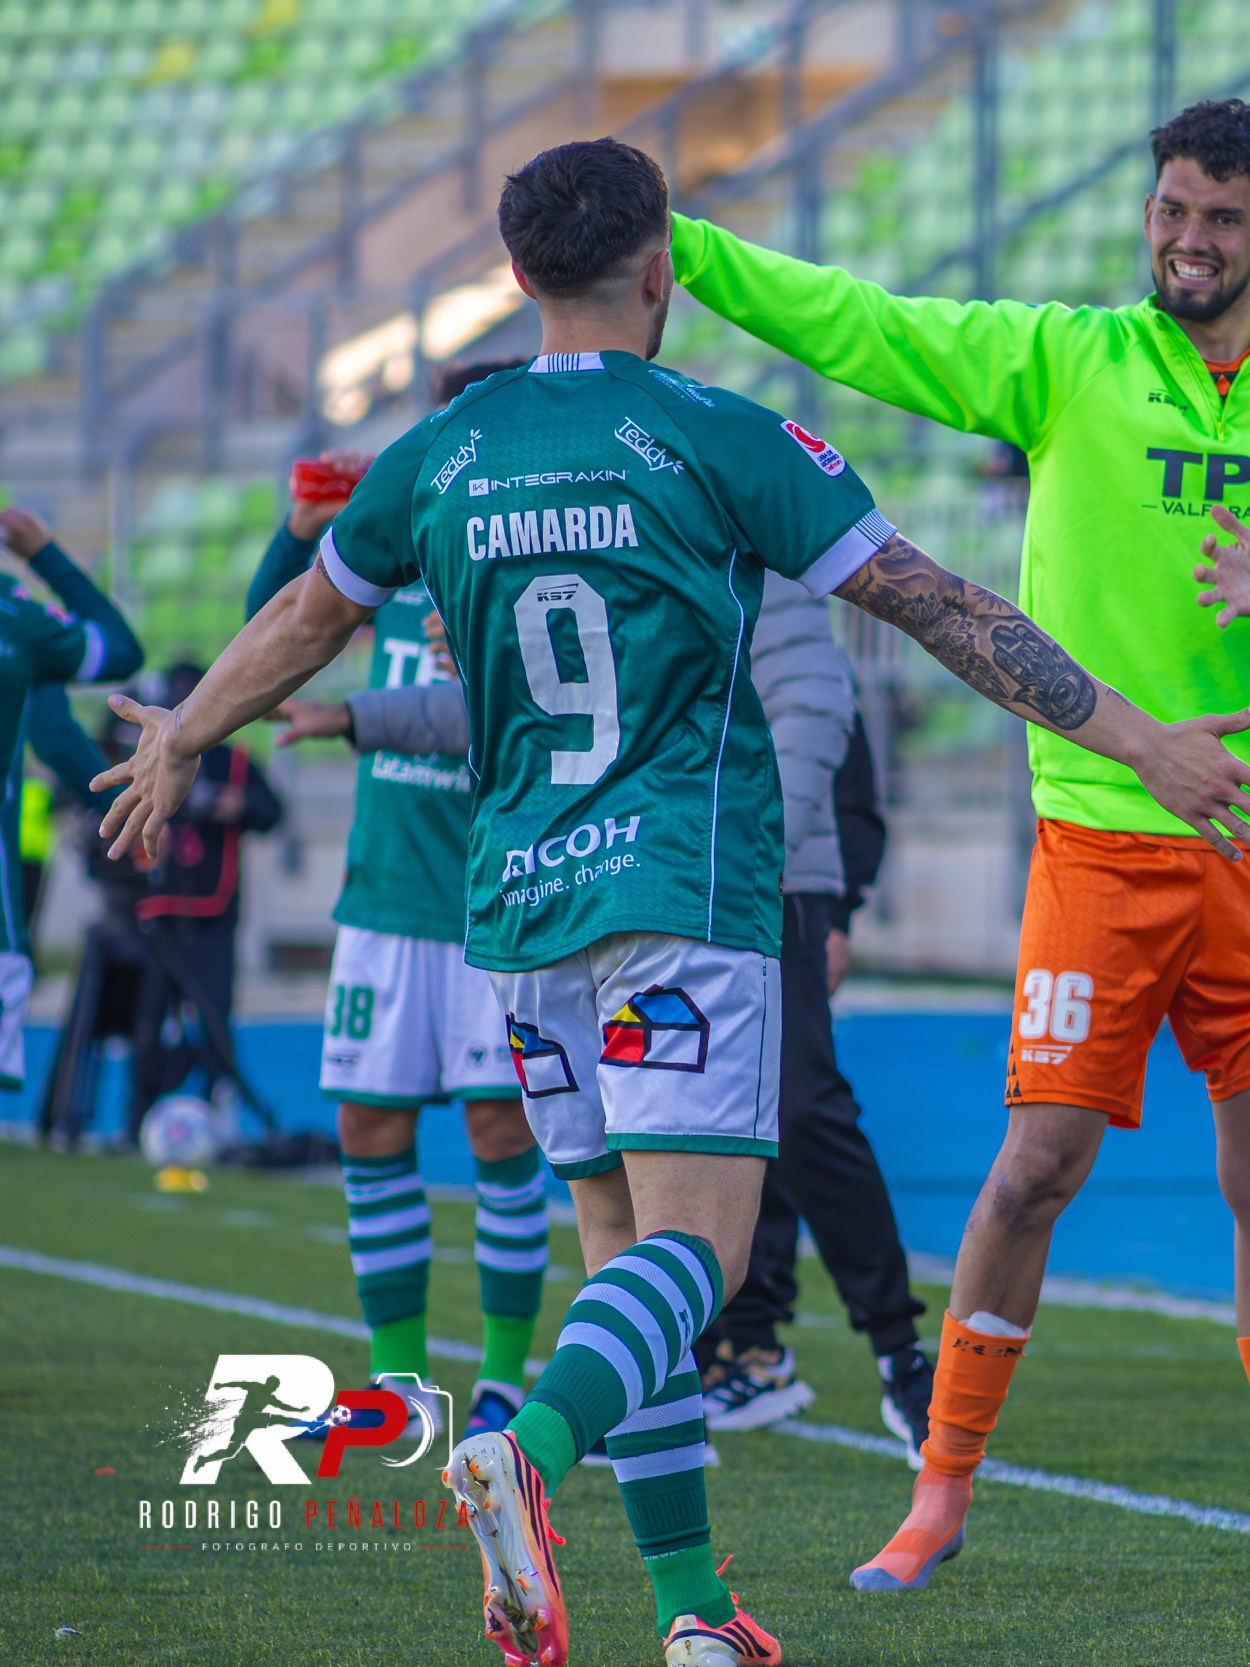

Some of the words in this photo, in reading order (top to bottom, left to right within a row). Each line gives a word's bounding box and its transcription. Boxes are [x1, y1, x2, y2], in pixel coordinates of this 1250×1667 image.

[431, 437, 478, 494] Teddy
[615, 417, 674, 472] Teddy
[491, 469, 626, 491] INTEGRAKIN
[467, 504, 638, 561] CAMARDA
[537, 587, 578, 602] KS7
[514, 573, 620, 784] 9
[502, 816, 640, 881] RICOH
[575, 852, 640, 885] change.
[1018, 969, 1094, 1043] 36
